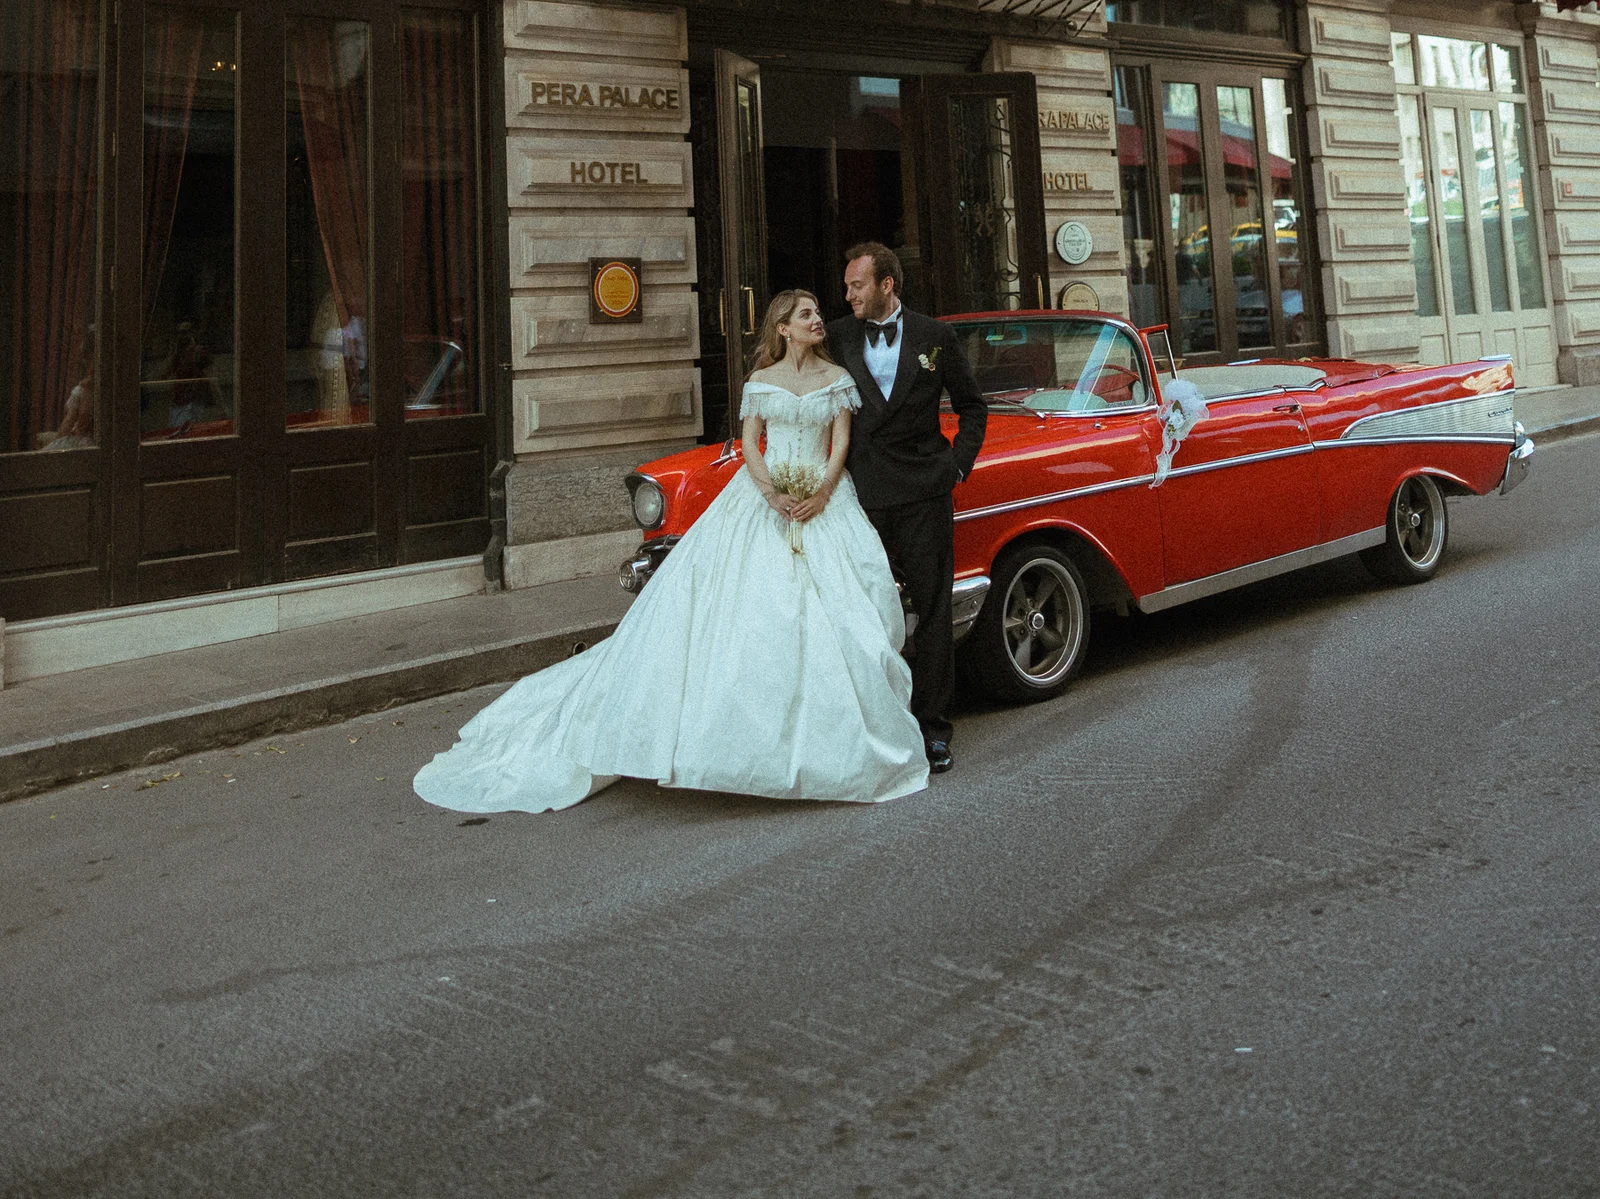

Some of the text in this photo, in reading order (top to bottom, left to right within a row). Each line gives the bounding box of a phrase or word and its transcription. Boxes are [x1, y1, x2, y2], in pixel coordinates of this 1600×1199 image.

[531, 81, 679, 110] PERA PALACE
[1038, 110, 1109, 131] RA PALACE
[570, 161, 649, 184] HOTEL
[1043, 171, 1093, 191] HOTEL
